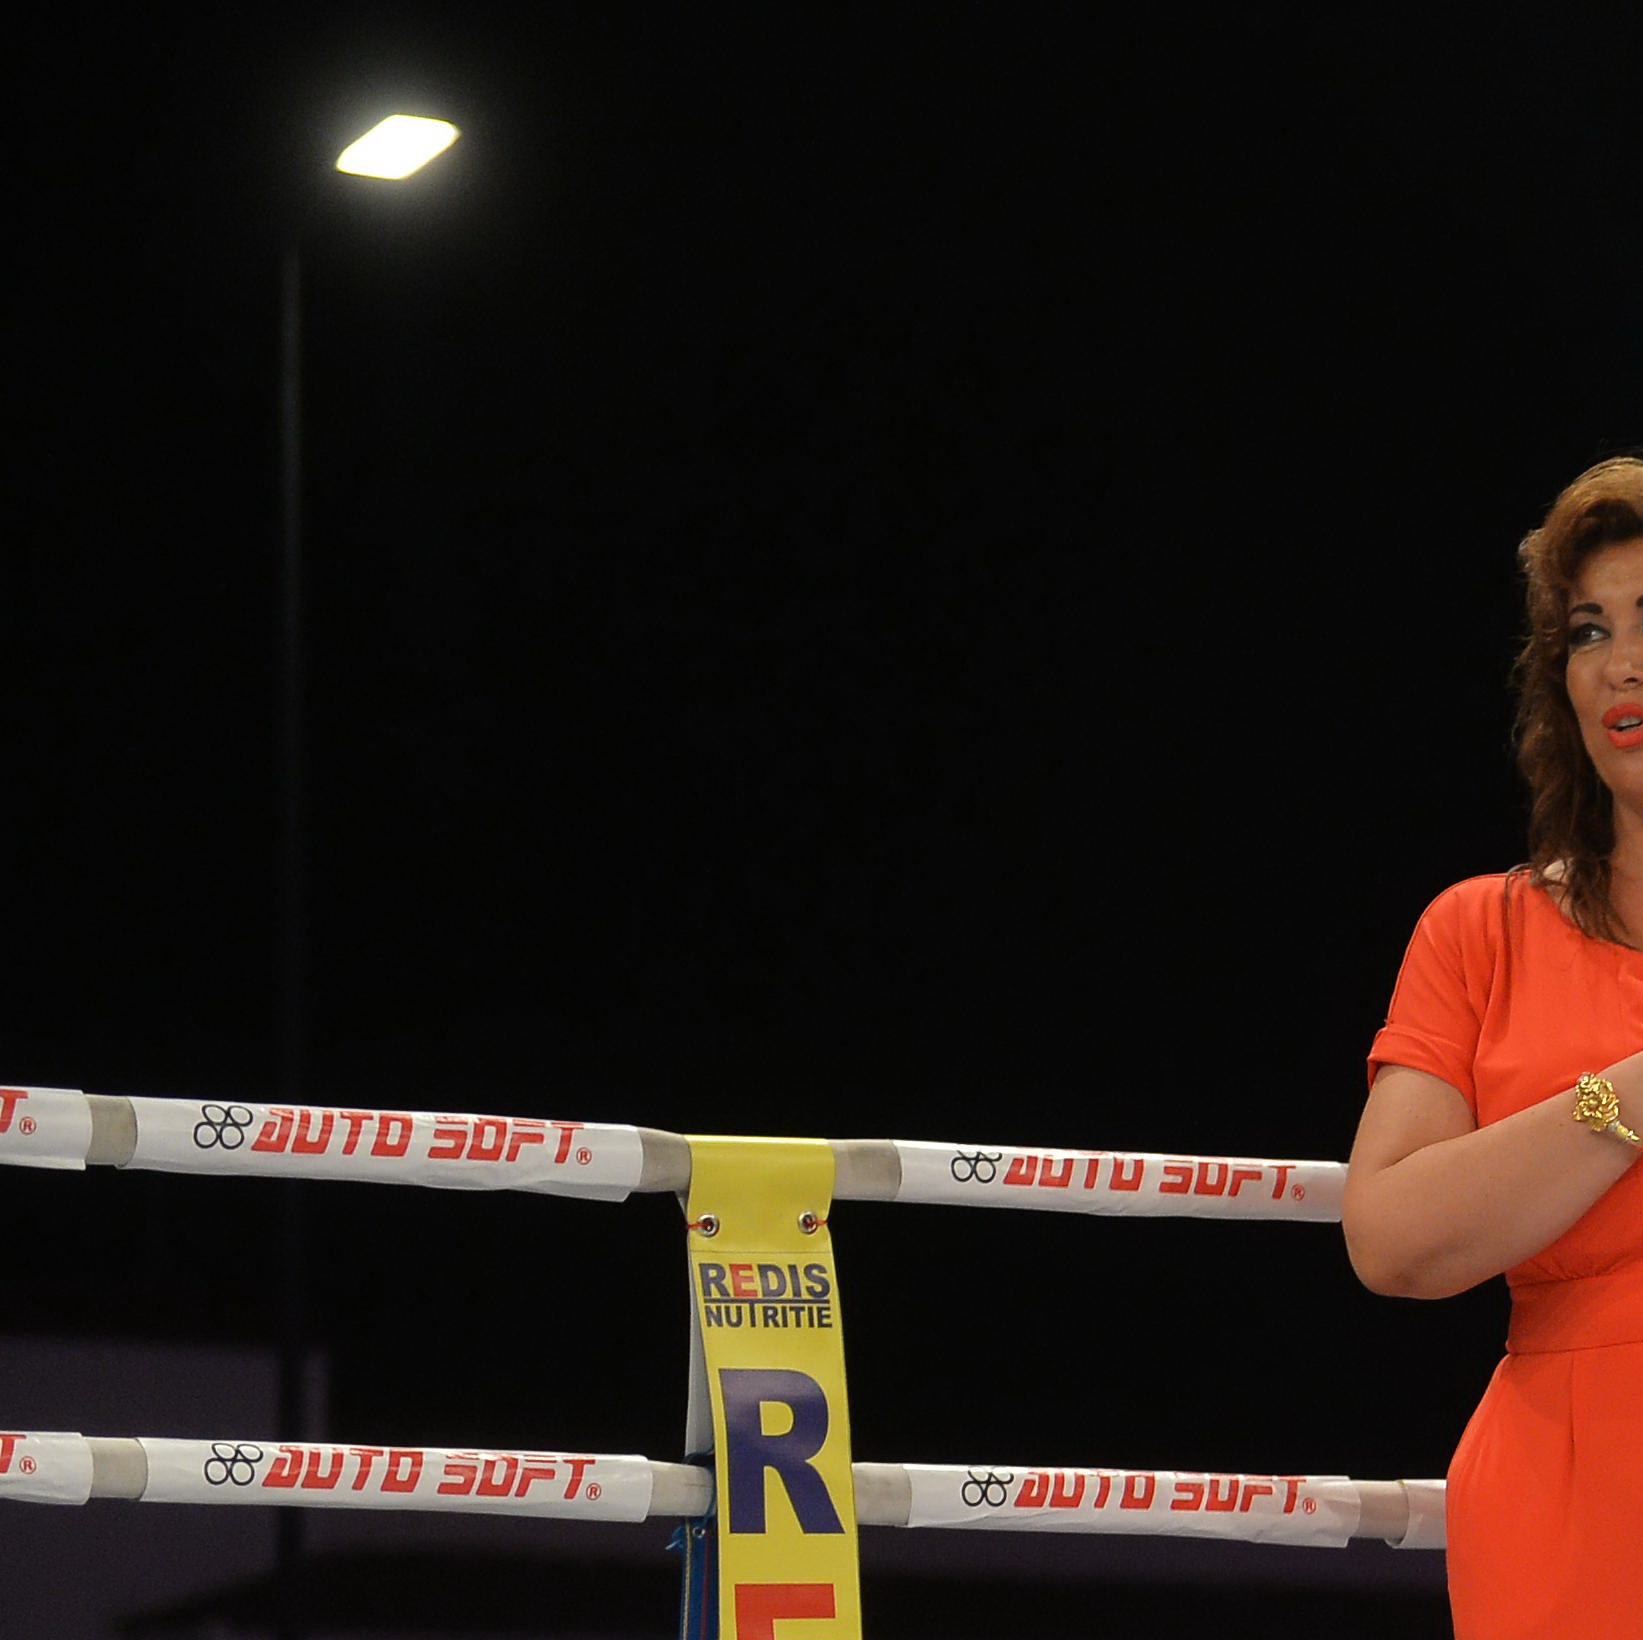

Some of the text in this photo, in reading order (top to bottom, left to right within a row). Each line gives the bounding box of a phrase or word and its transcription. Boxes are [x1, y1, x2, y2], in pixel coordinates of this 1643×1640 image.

[251, 1107, 585, 1164] AUTO SOFT
[1003, 1153, 1296, 1200] AUTO SOFT
[698, 1263, 831, 1298] REDIS
[705, 1301, 833, 1328] NUTRITIE
[262, 1445, 597, 1499] AUTO SOFT
[1013, 1470, 1306, 1515] AUTO SOFT
